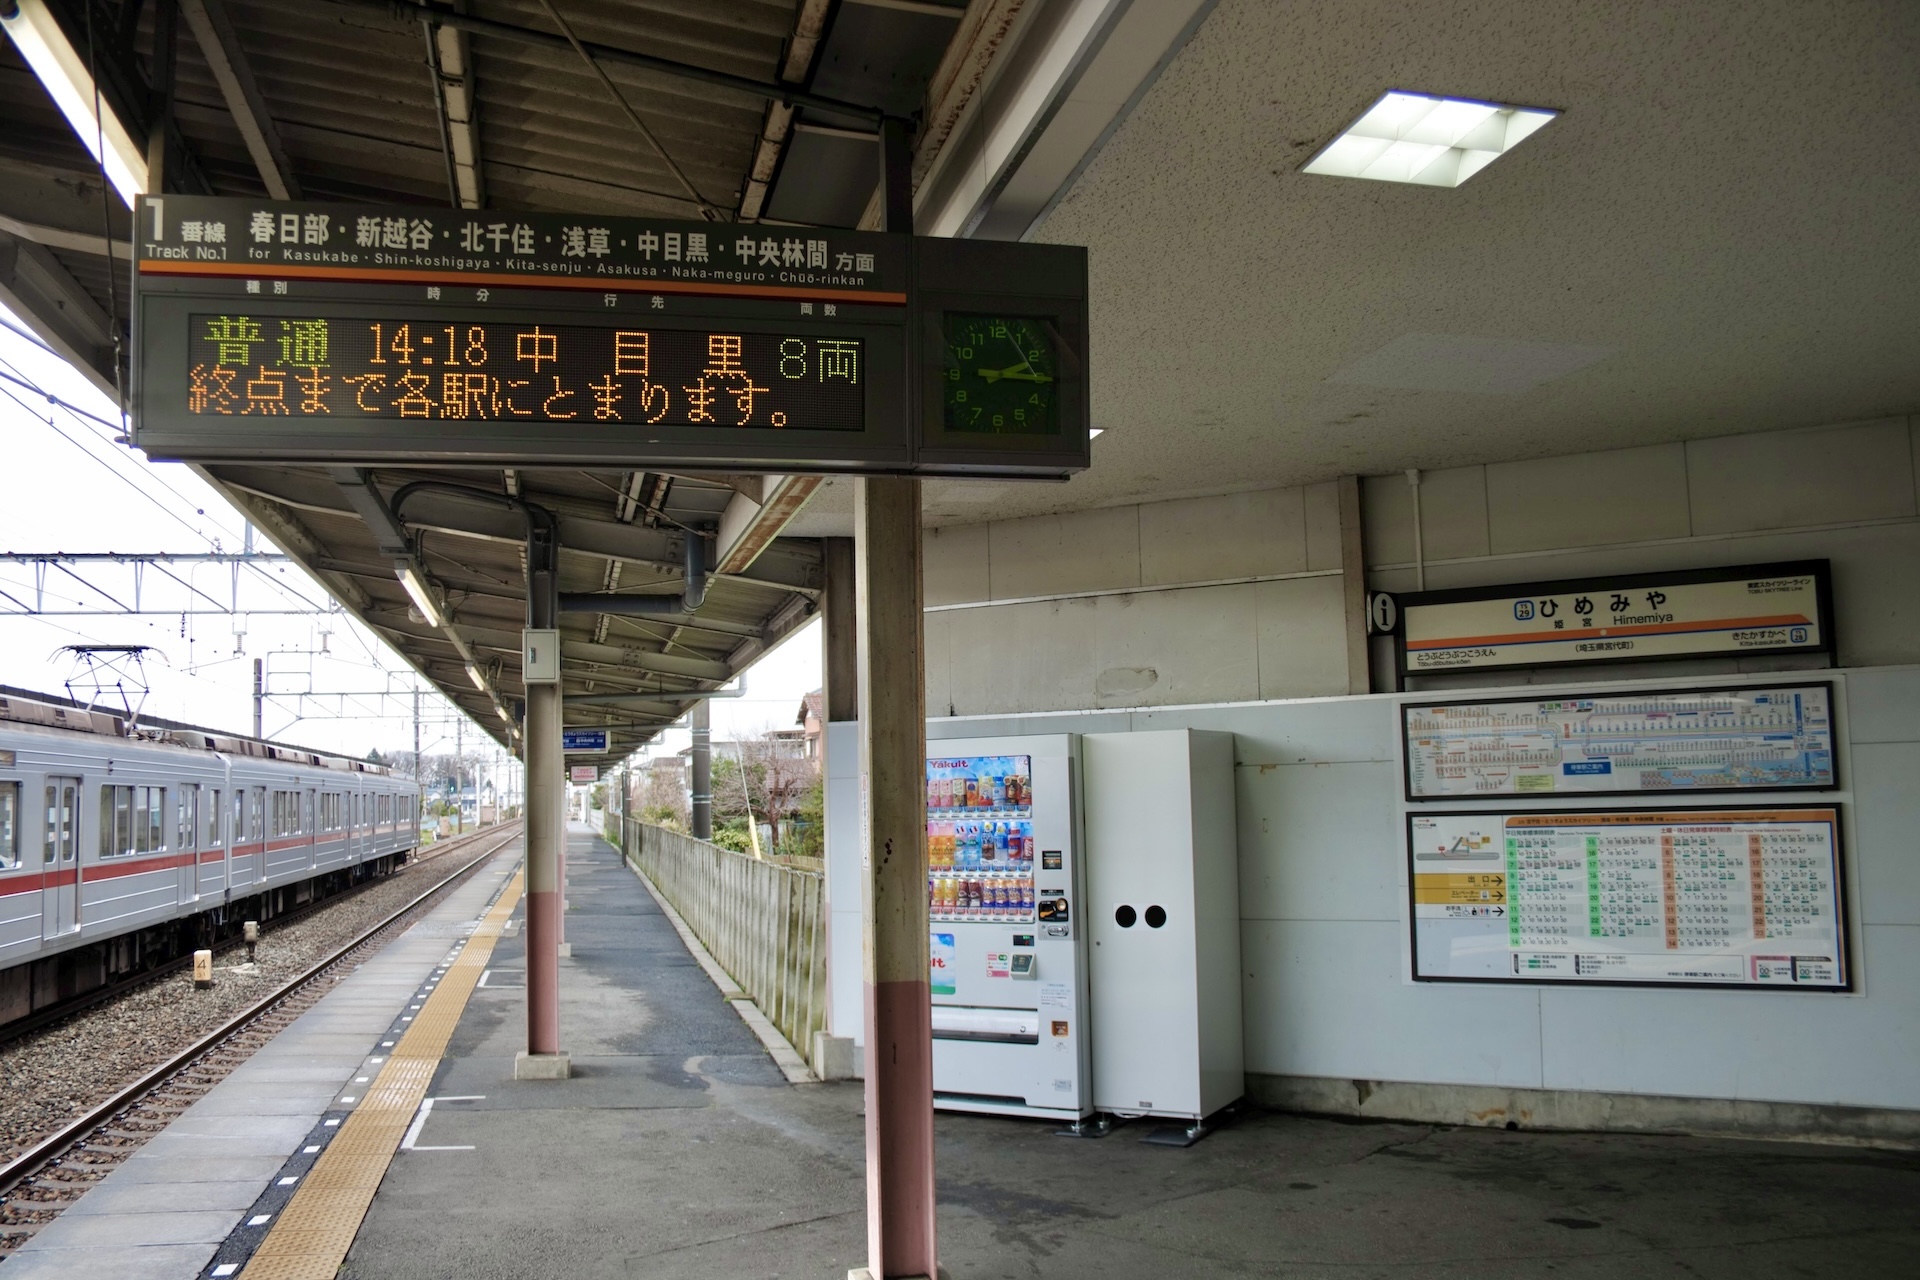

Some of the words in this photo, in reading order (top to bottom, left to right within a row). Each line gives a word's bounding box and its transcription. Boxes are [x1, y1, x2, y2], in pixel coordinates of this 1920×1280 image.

[146, 198, 163, 241] 1
[181, 221, 226, 244] 番線
[146, 244, 189, 259] Track
[196, 246, 227, 261] No.1
[249, 248, 270, 259] for
[284, 248, 359, 263] Kasukabe
[375, 253, 490, 271] Shin-koshigaya
[506, 259, 581, 275] Kita-senju
[597, 263, 657, 276] Asakusa
[672, 266, 765, 282] Naka-meguro
[780, 272, 864, 286] Chūō-rinkan
[835, 252, 875, 273] 方面
[247, 280, 287, 294] 種別
[989, 326, 1007, 339] 12
[1016, 333, 1021, 345] 1
[204, 316, 330, 367] 普通
[370, 323, 488, 367] 14:18
[970, 333, 984, 346] 11
[956, 347, 973, 360] 10
[1029, 350, 1039, 362] 2
[950, 368, 960, 380] 9
[956, 390, 967, 402] 8
[1028, 393, 1039, 405] 4
[971, 407, 982, 419] 7
[1014, 409, 1025, 421] 5
[992, 415, 1003, 427] 6
[1539, 591, 1667, 618] ひめみや
[1519, 609, 1530, 618] 29
[1613, 613, 1674, 626] Himemiya
[930, 760, 968, 768] Yakult
[197, 959, 206, 970] 4
